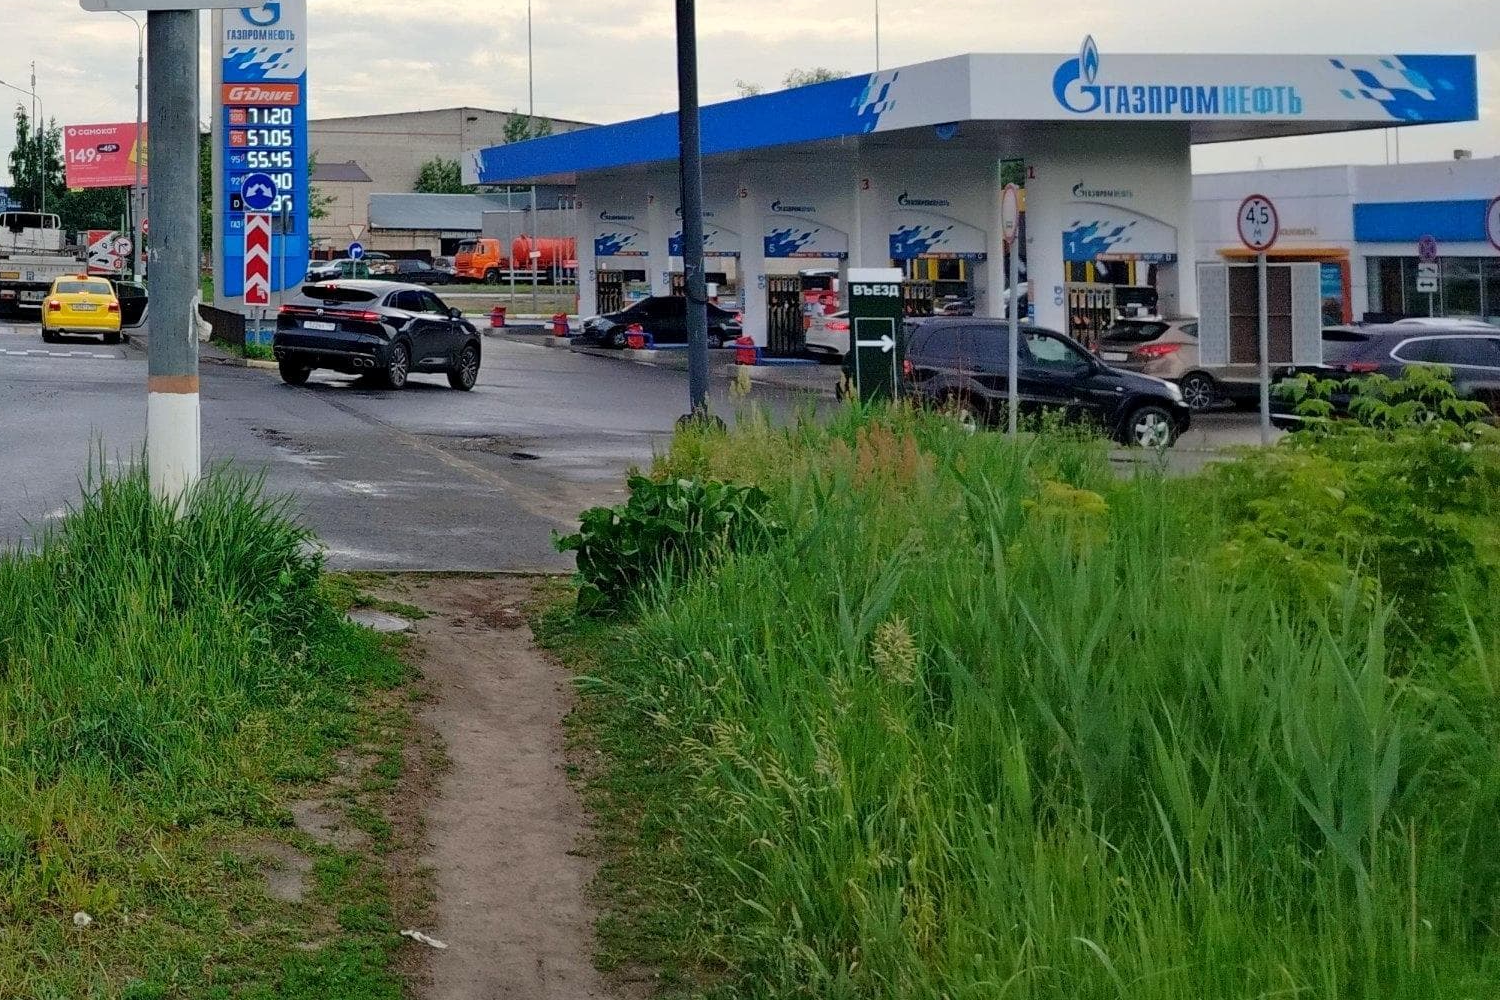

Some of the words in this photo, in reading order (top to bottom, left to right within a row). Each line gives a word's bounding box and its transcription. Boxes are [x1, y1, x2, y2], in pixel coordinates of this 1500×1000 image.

[227, 29, 295, 40] ГАЗПРОМНЕФТЬ
[1103, 85, 1303, 114] ГАЗПРОМНЕФТЬ
[248, 108, 292, 124] 71.20
[247, 129, 292, 146] 57.05
[230, 155, 241, 164] 95
[247, 151, 292, 168] 55.45
[1246, 206, 1269, 225] 4,5
[1069, 241, 1076, 254] 1
[853, 284, 900, 298] ВЪЕЗД
